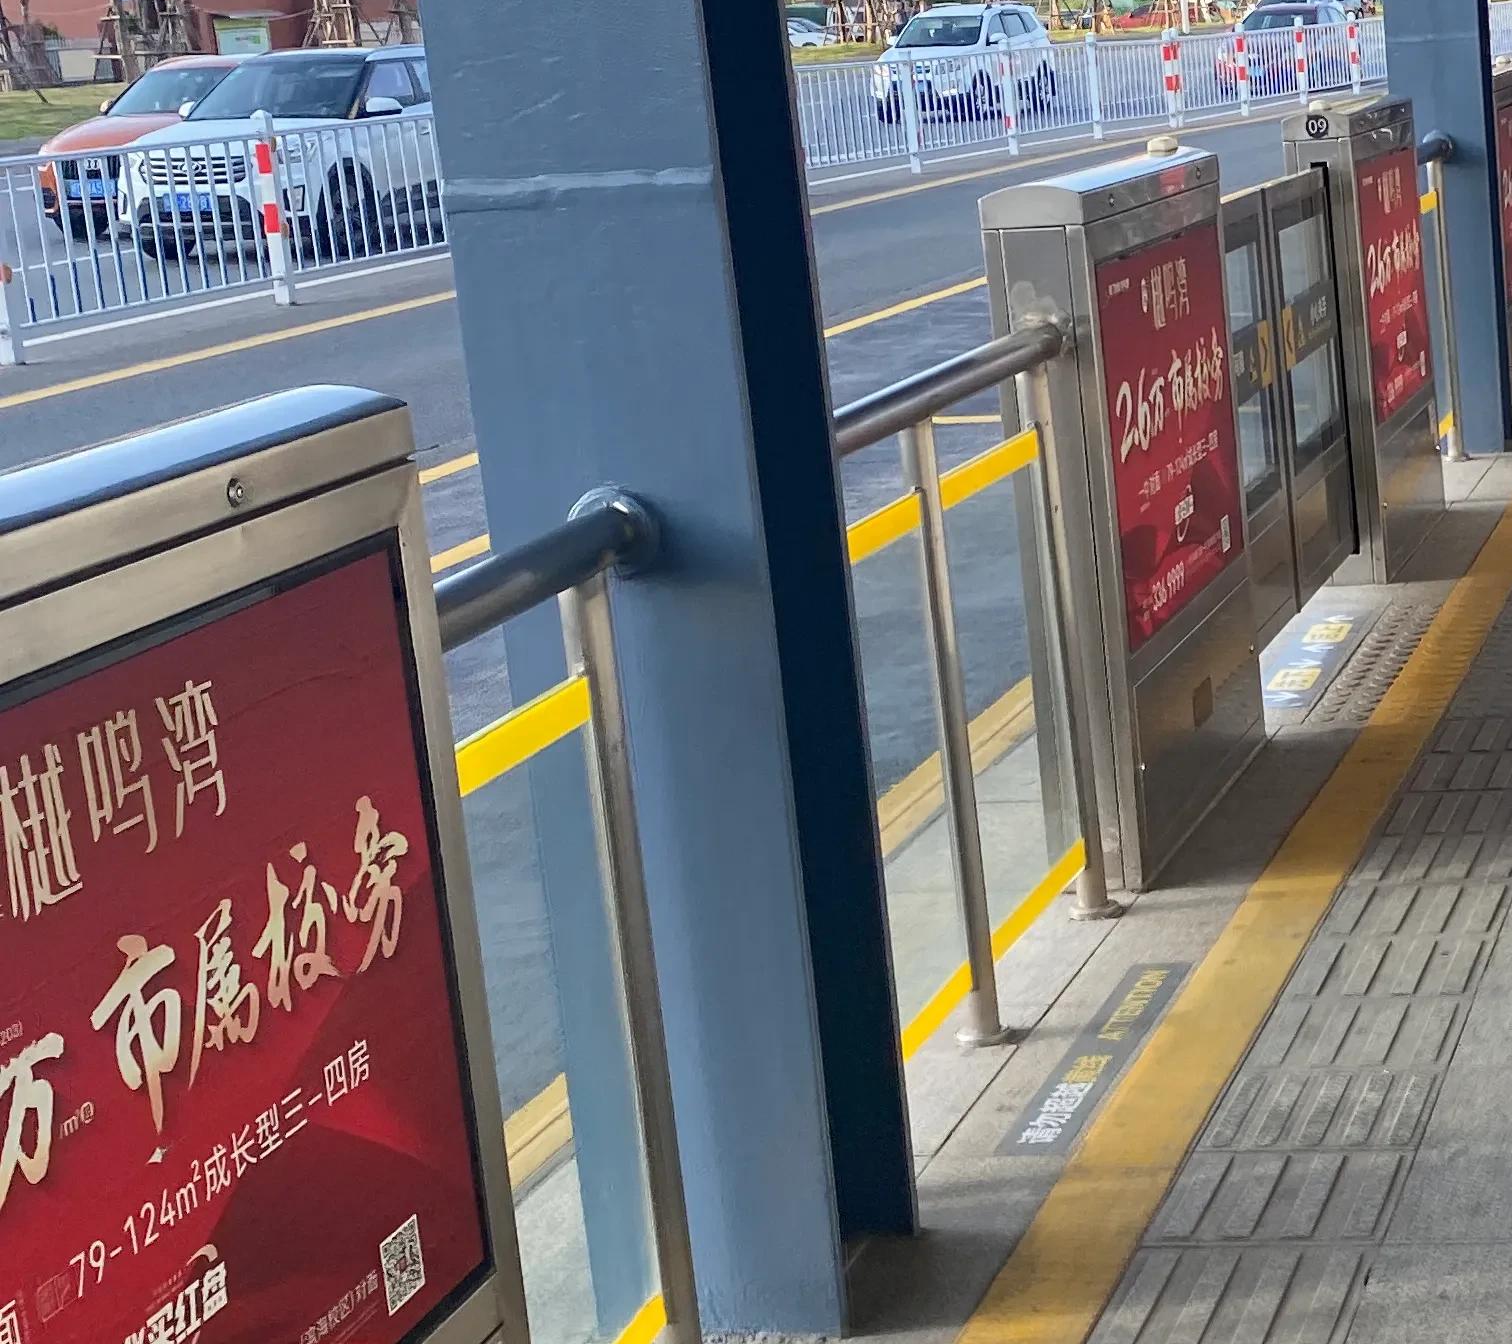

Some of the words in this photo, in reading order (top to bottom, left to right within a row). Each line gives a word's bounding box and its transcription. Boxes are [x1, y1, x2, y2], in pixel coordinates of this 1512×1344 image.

[1308, 119, 1327, 134] 09
[1166, 560, 1185, 597] 9999
[0, 680, 226, 922] 樾鸣湾
[90, 795, 410, 1136] 市属校旁
[1096, 968, 1172, 1042] ATTENTION
